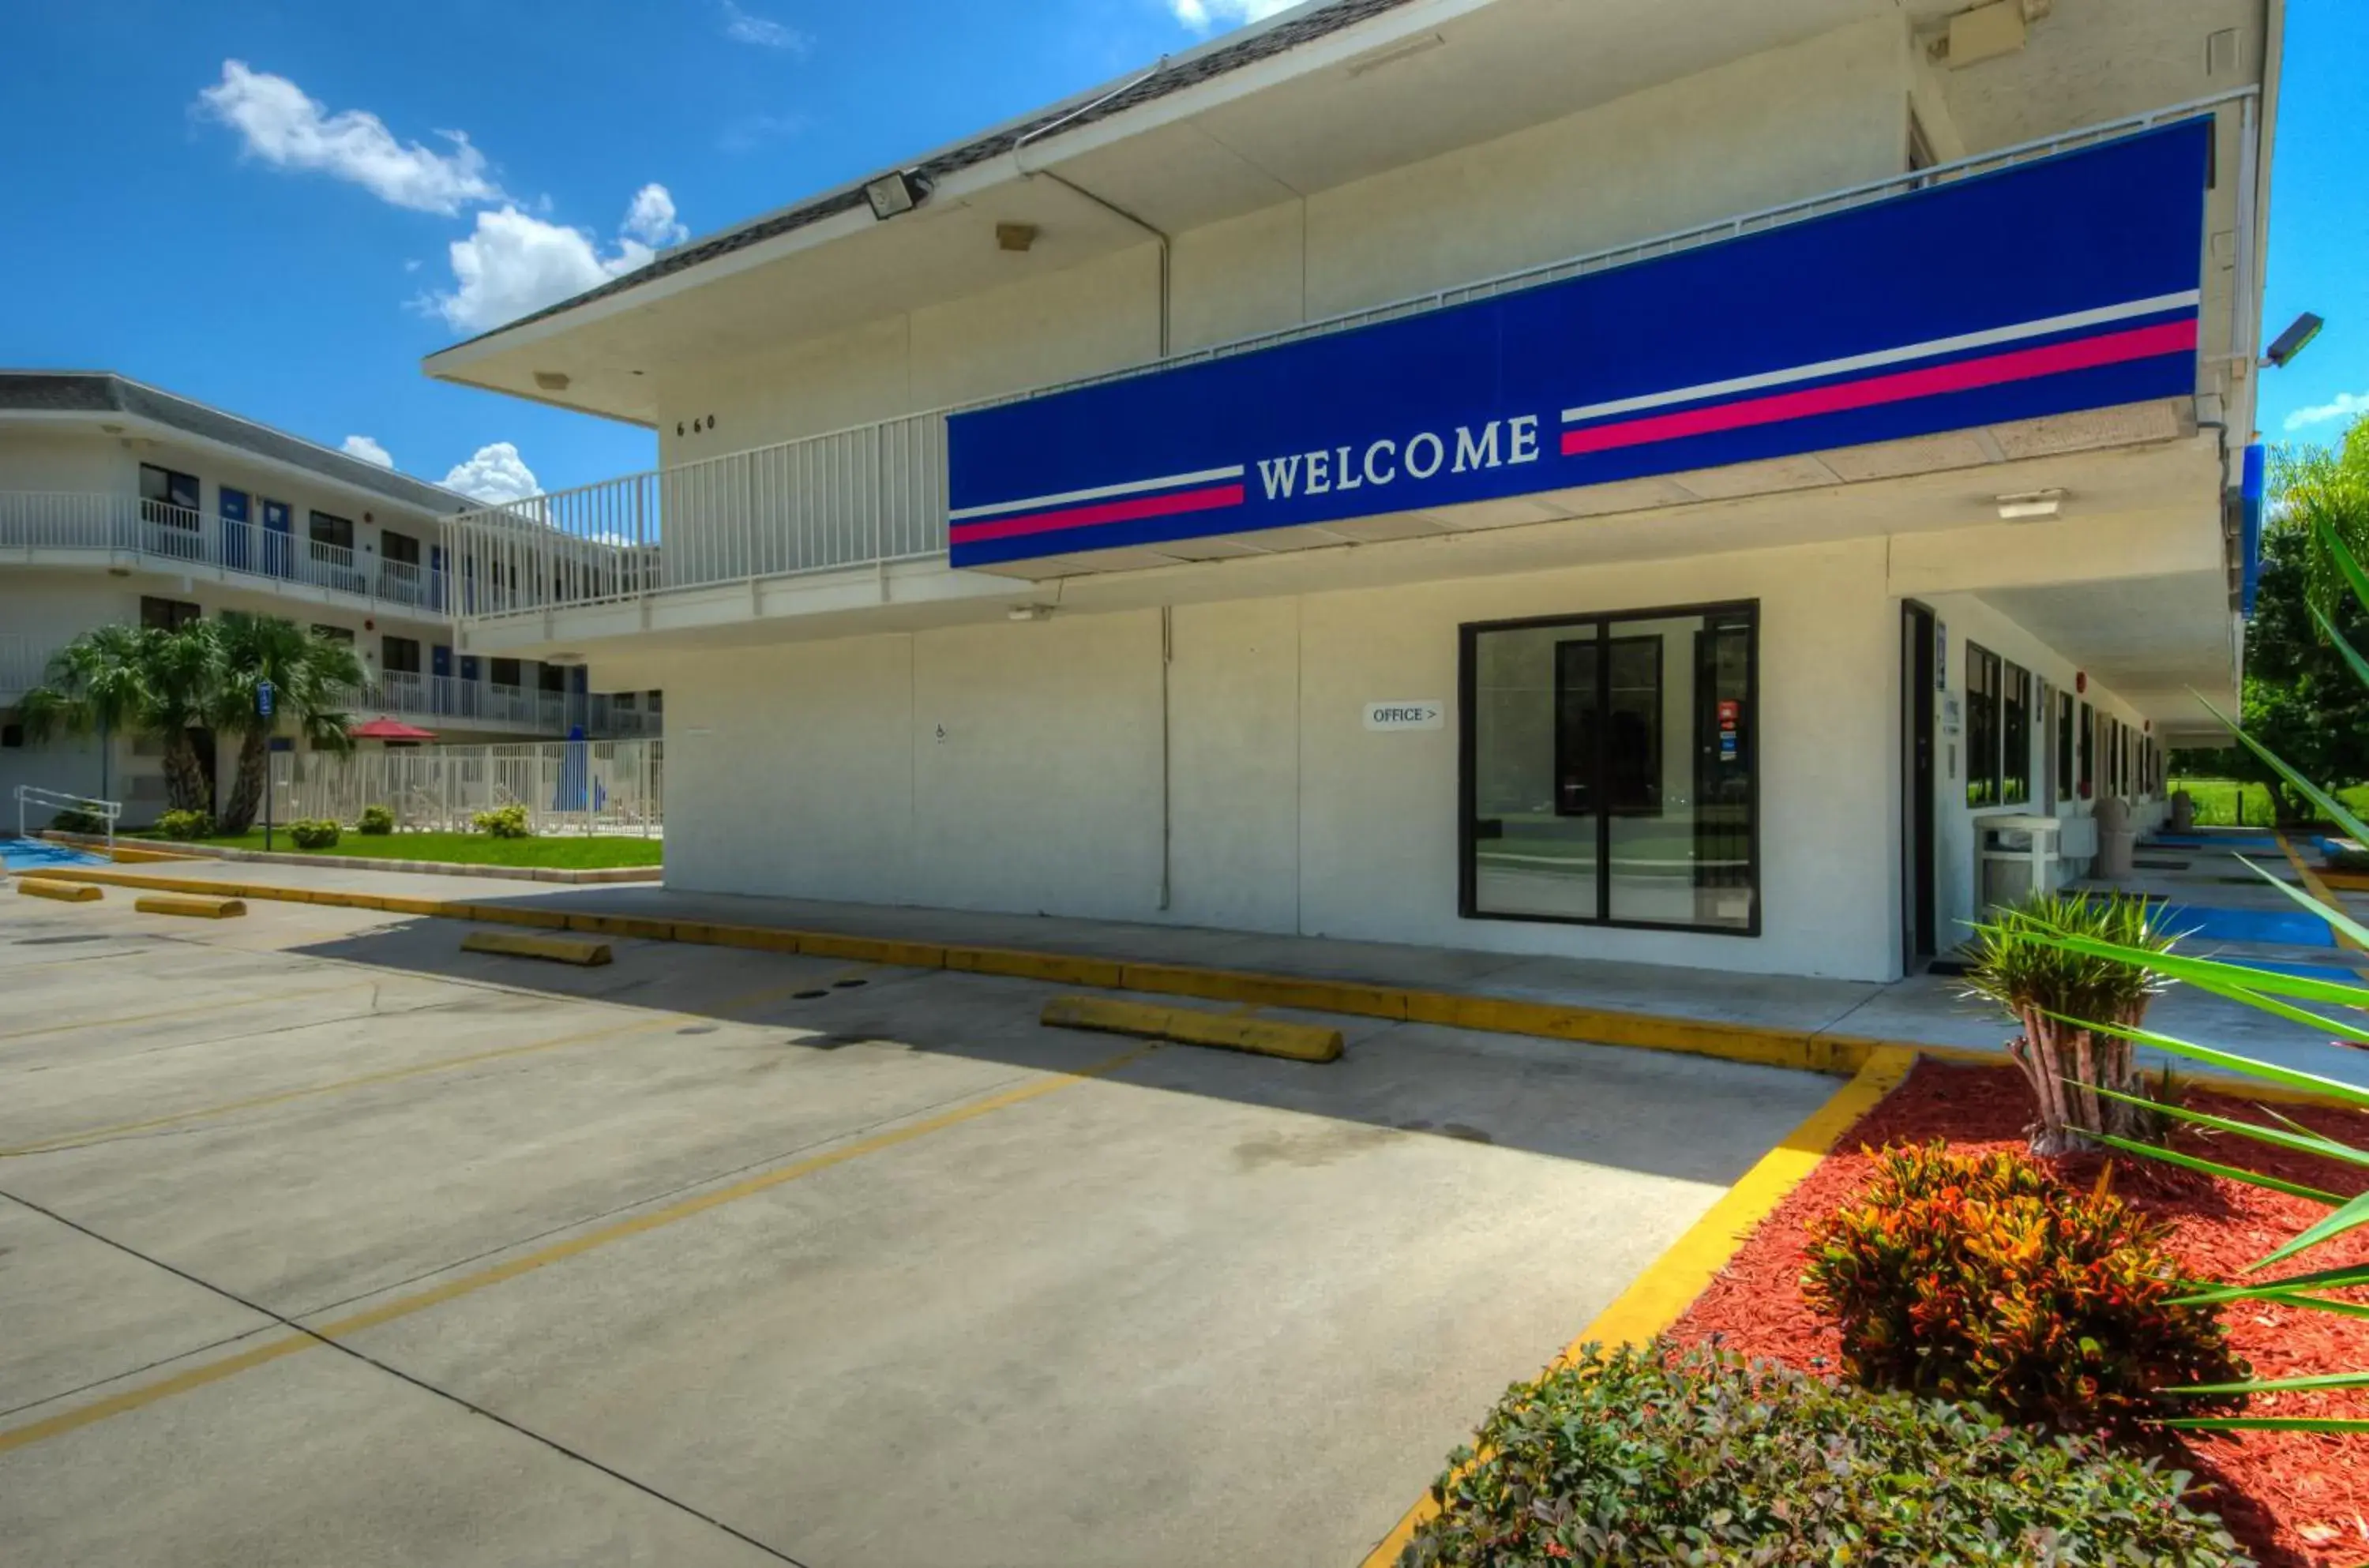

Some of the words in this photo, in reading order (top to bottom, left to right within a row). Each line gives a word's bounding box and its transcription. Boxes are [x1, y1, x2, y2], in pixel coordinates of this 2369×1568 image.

[677, 415, 715, 437] 660
[1257, 415, 1540, 500] WELCOME
[1373, 708, 1422, 722] OFFICE
